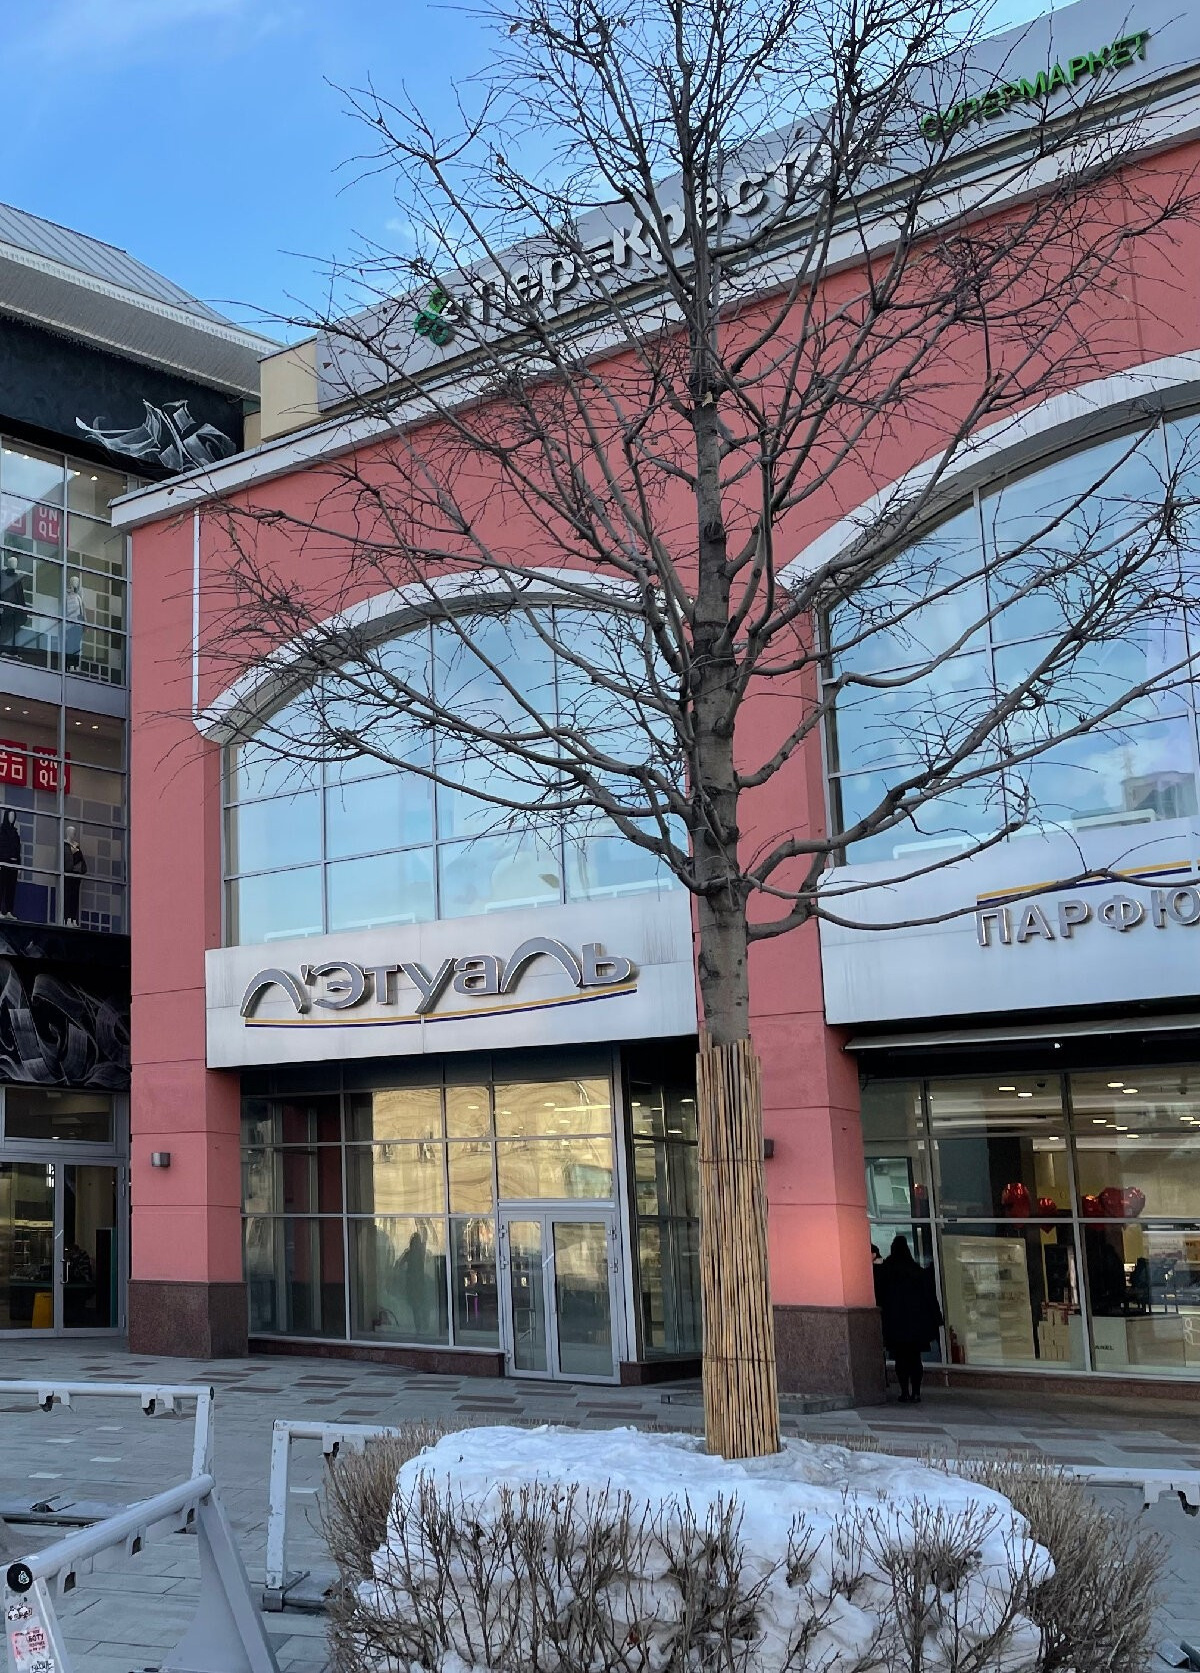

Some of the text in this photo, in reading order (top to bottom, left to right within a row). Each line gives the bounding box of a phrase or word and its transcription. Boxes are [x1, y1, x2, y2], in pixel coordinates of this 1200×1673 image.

[919, 28, 1151, 139] СУПЕРМАРКЕТ
[39, 520, 60, 538] QL
[40, 506, 58, 521] UN
[976, 886, 1200, 946] ПАРФЮ
